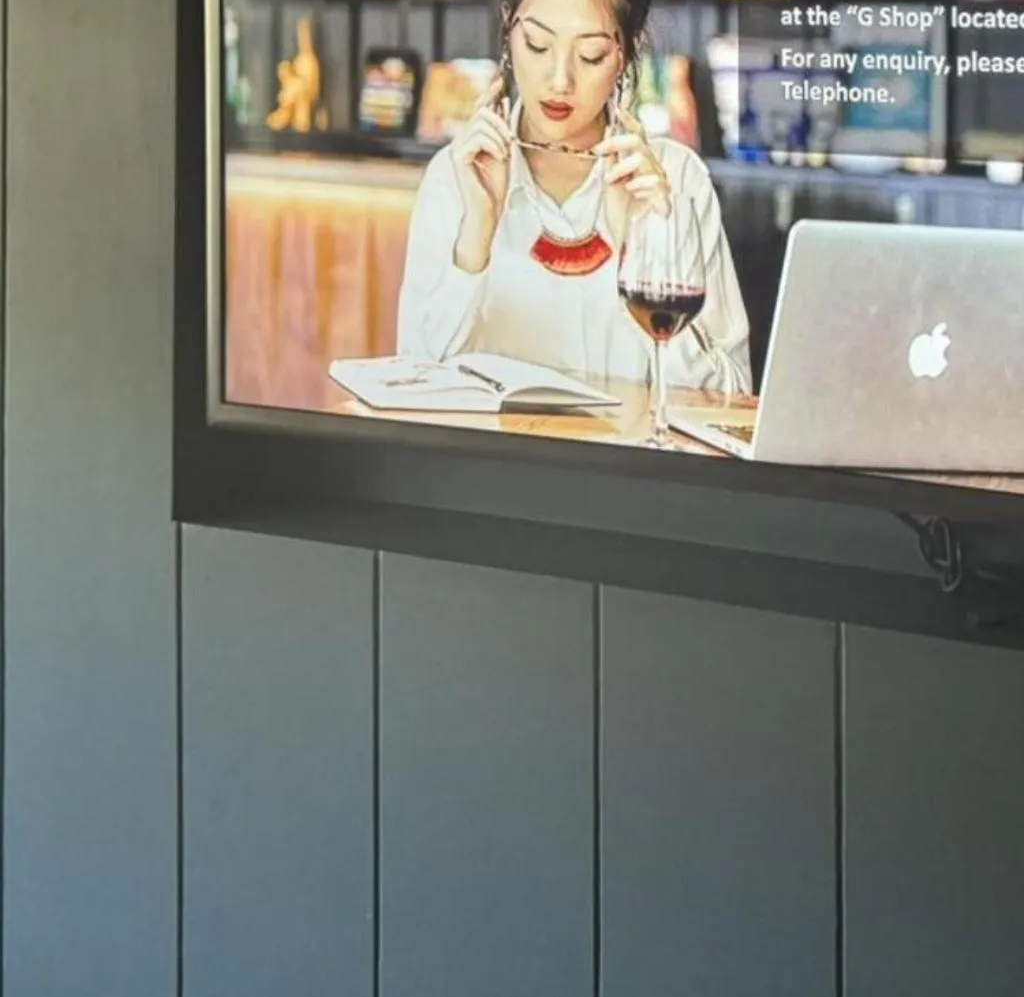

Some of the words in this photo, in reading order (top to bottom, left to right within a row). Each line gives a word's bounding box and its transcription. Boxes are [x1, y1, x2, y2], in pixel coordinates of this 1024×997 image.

[780, 8, 804, 26] at
[808, 5, 841, 27] the
[846, 7, 874, 27] “G
[878, 6, 944, 32] Shop”
[781, 48, 815, 68] For
[820, 52, 857, 73] any
[862, 51, 951, 75] enquiry,
[781, 81, 896, 104] Telephone.
